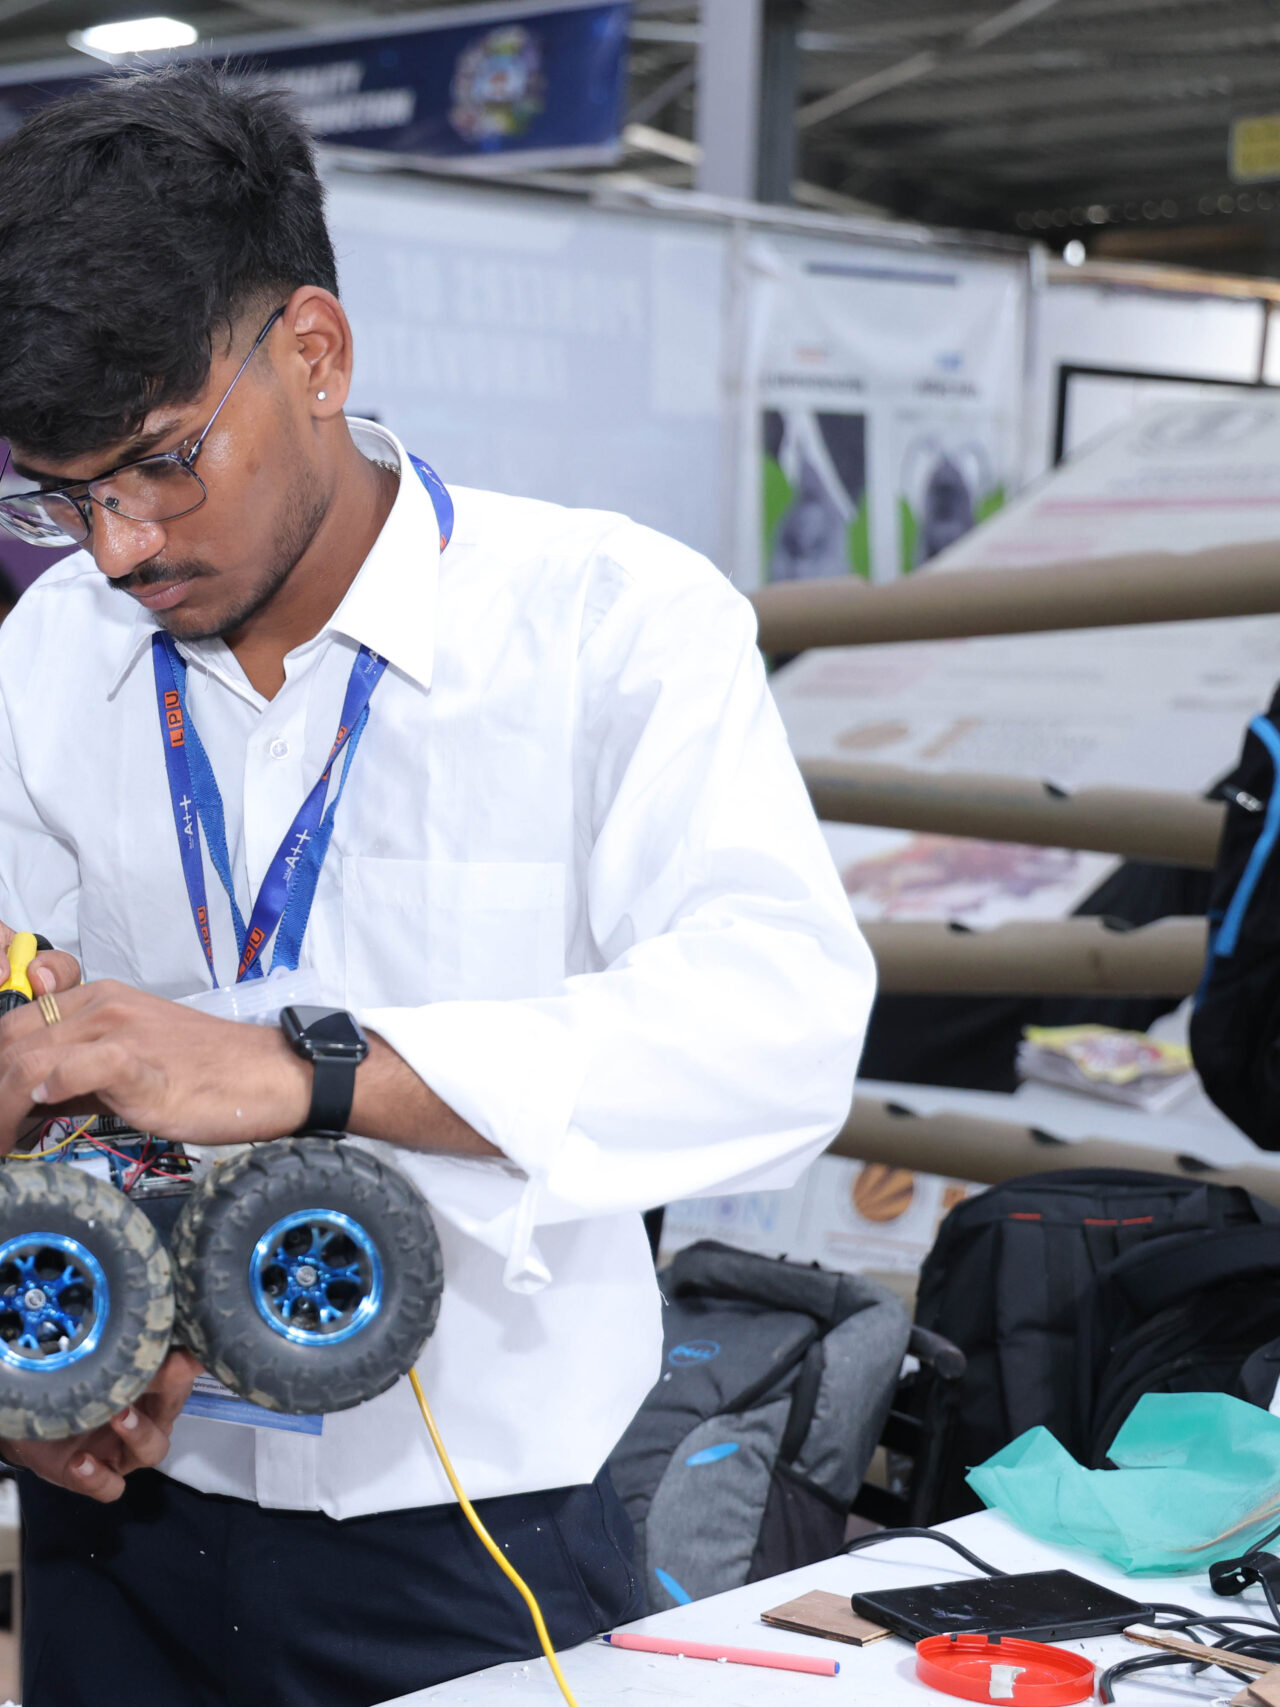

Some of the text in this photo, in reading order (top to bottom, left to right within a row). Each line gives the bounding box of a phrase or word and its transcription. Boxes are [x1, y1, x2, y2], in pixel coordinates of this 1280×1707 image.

[164, 690, 185, 747] LPU
[180, 795, 194, 835] A++
[285, 829, 312, 869] A++
